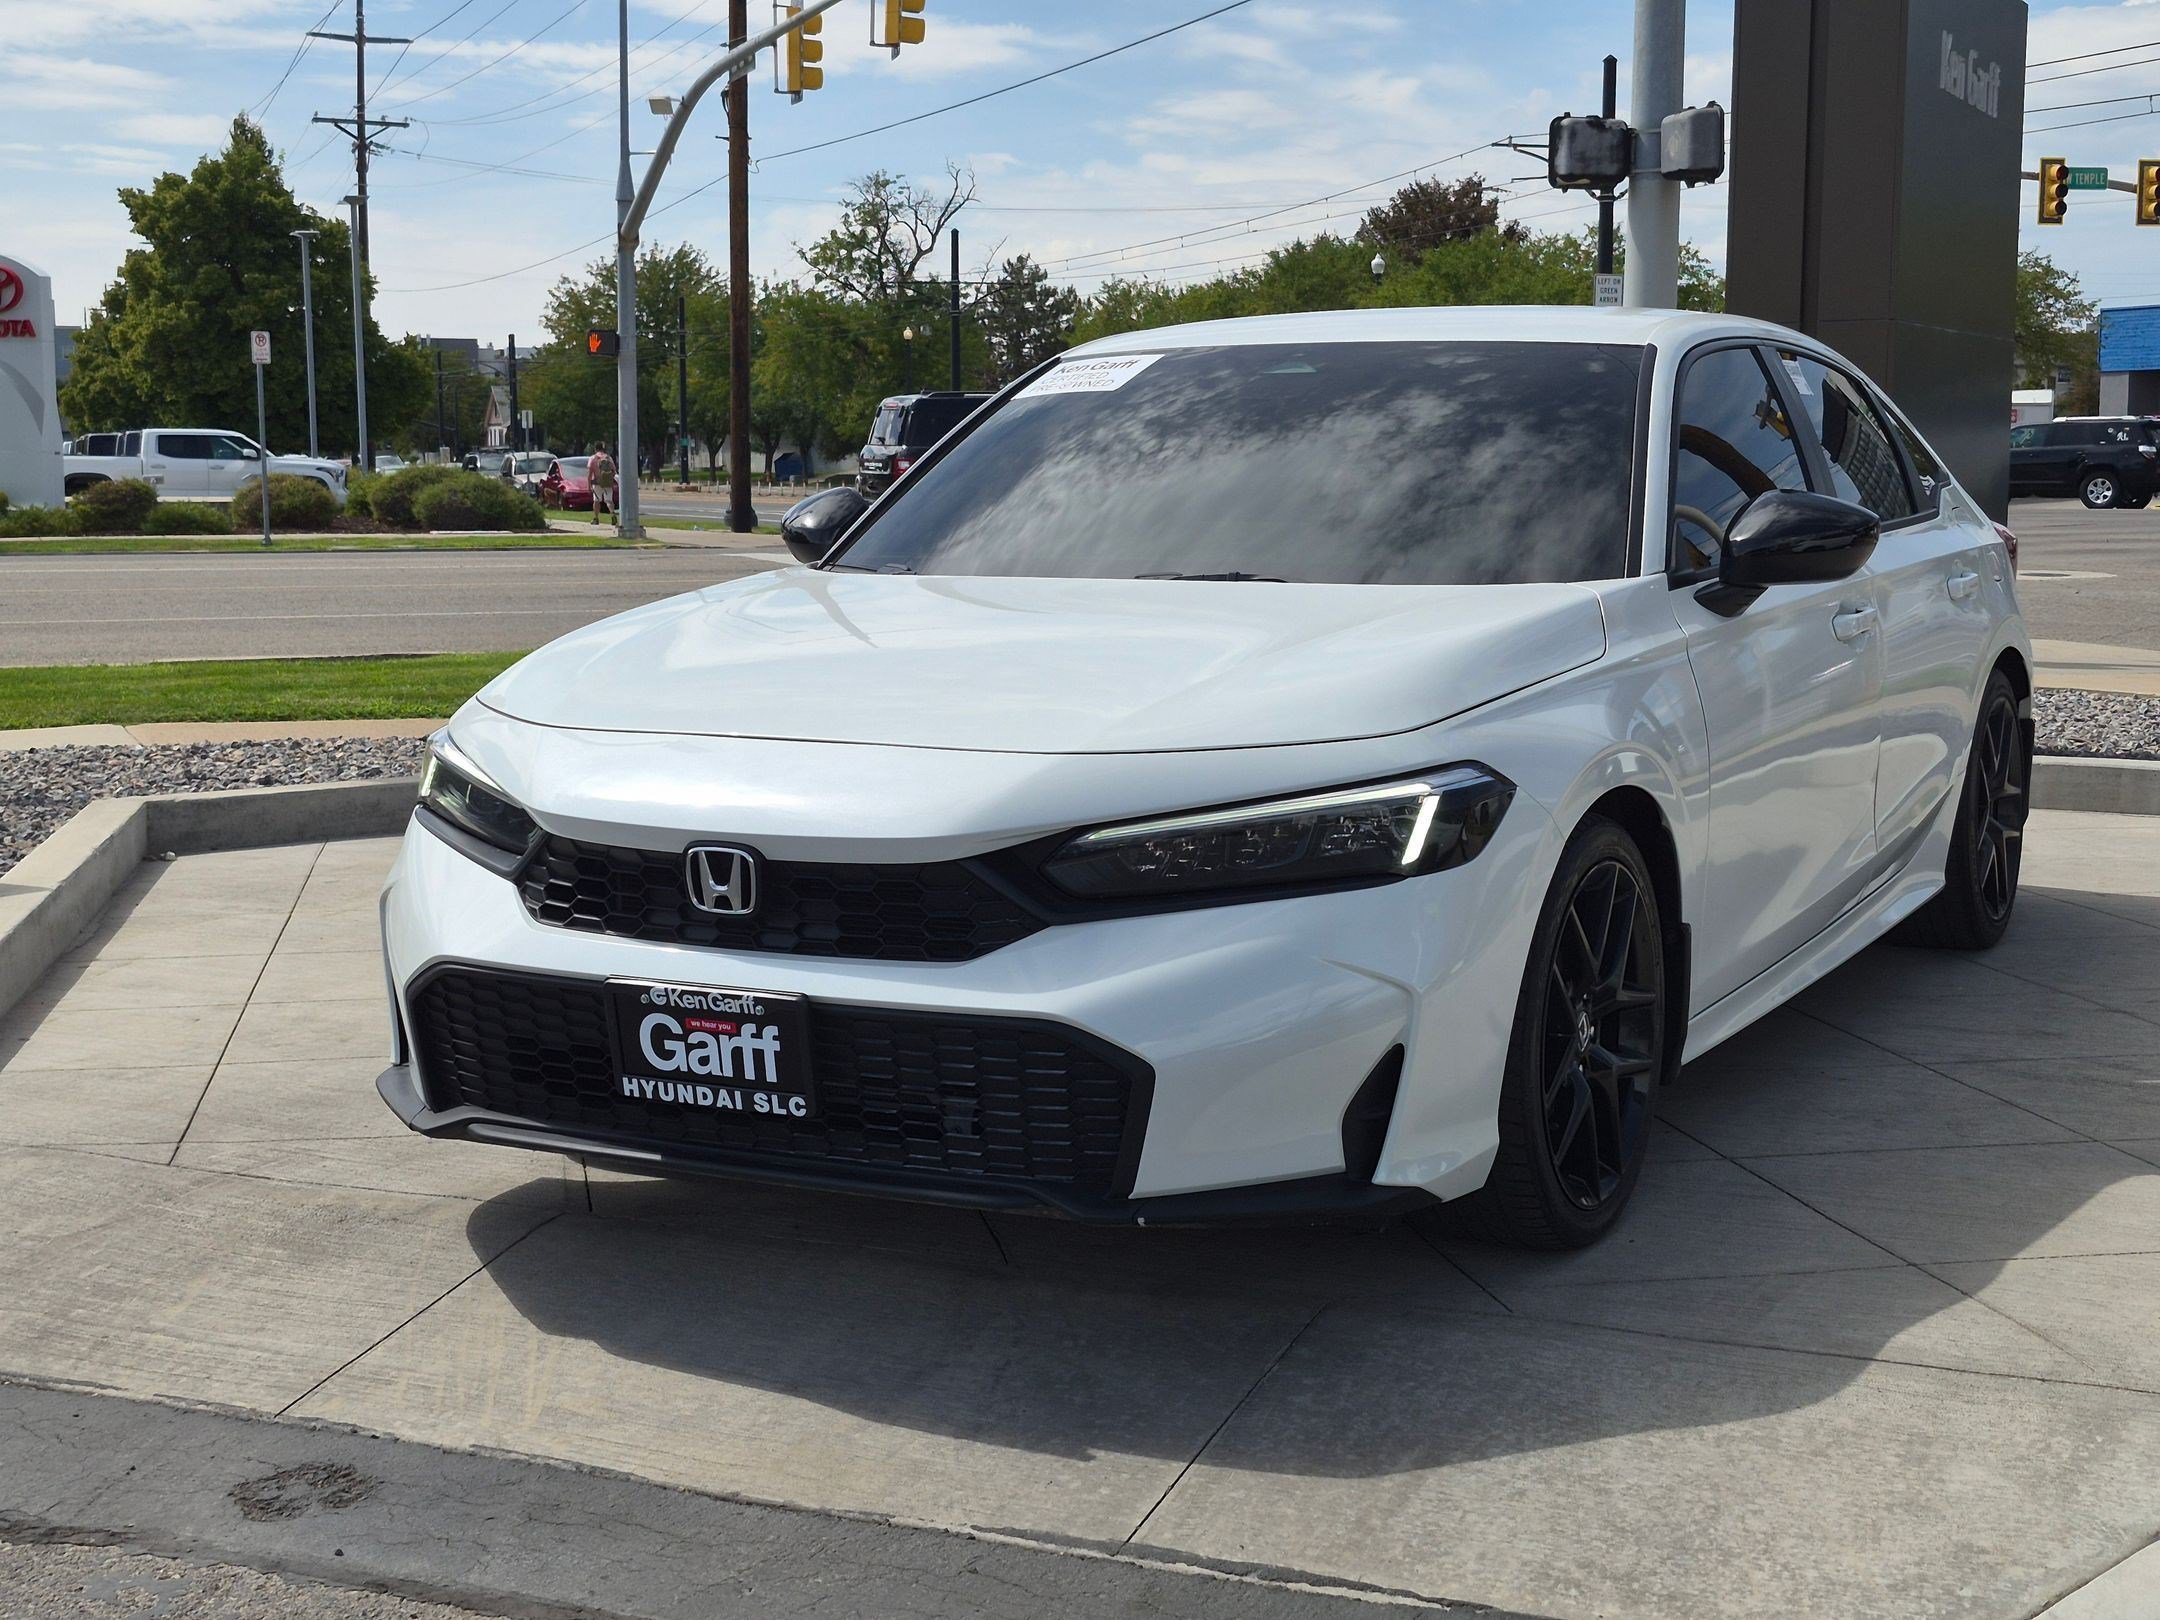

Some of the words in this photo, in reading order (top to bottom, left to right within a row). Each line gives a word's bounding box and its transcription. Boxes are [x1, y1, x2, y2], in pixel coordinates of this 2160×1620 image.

[2075, 172, 2105, 185] TEMPLE
[1597, 277, 1611, 285] LEFT
[1600, 296, 1618, 304] ARROW
[701, 1020, 717, 1029] hear
[718, 1023, 731, 1031] you
[639, 1012, 781, 1083] Garff
[622, 1076, 743, 1110] HYUNDAI
[753, 1092, 807, 1117] SLC
